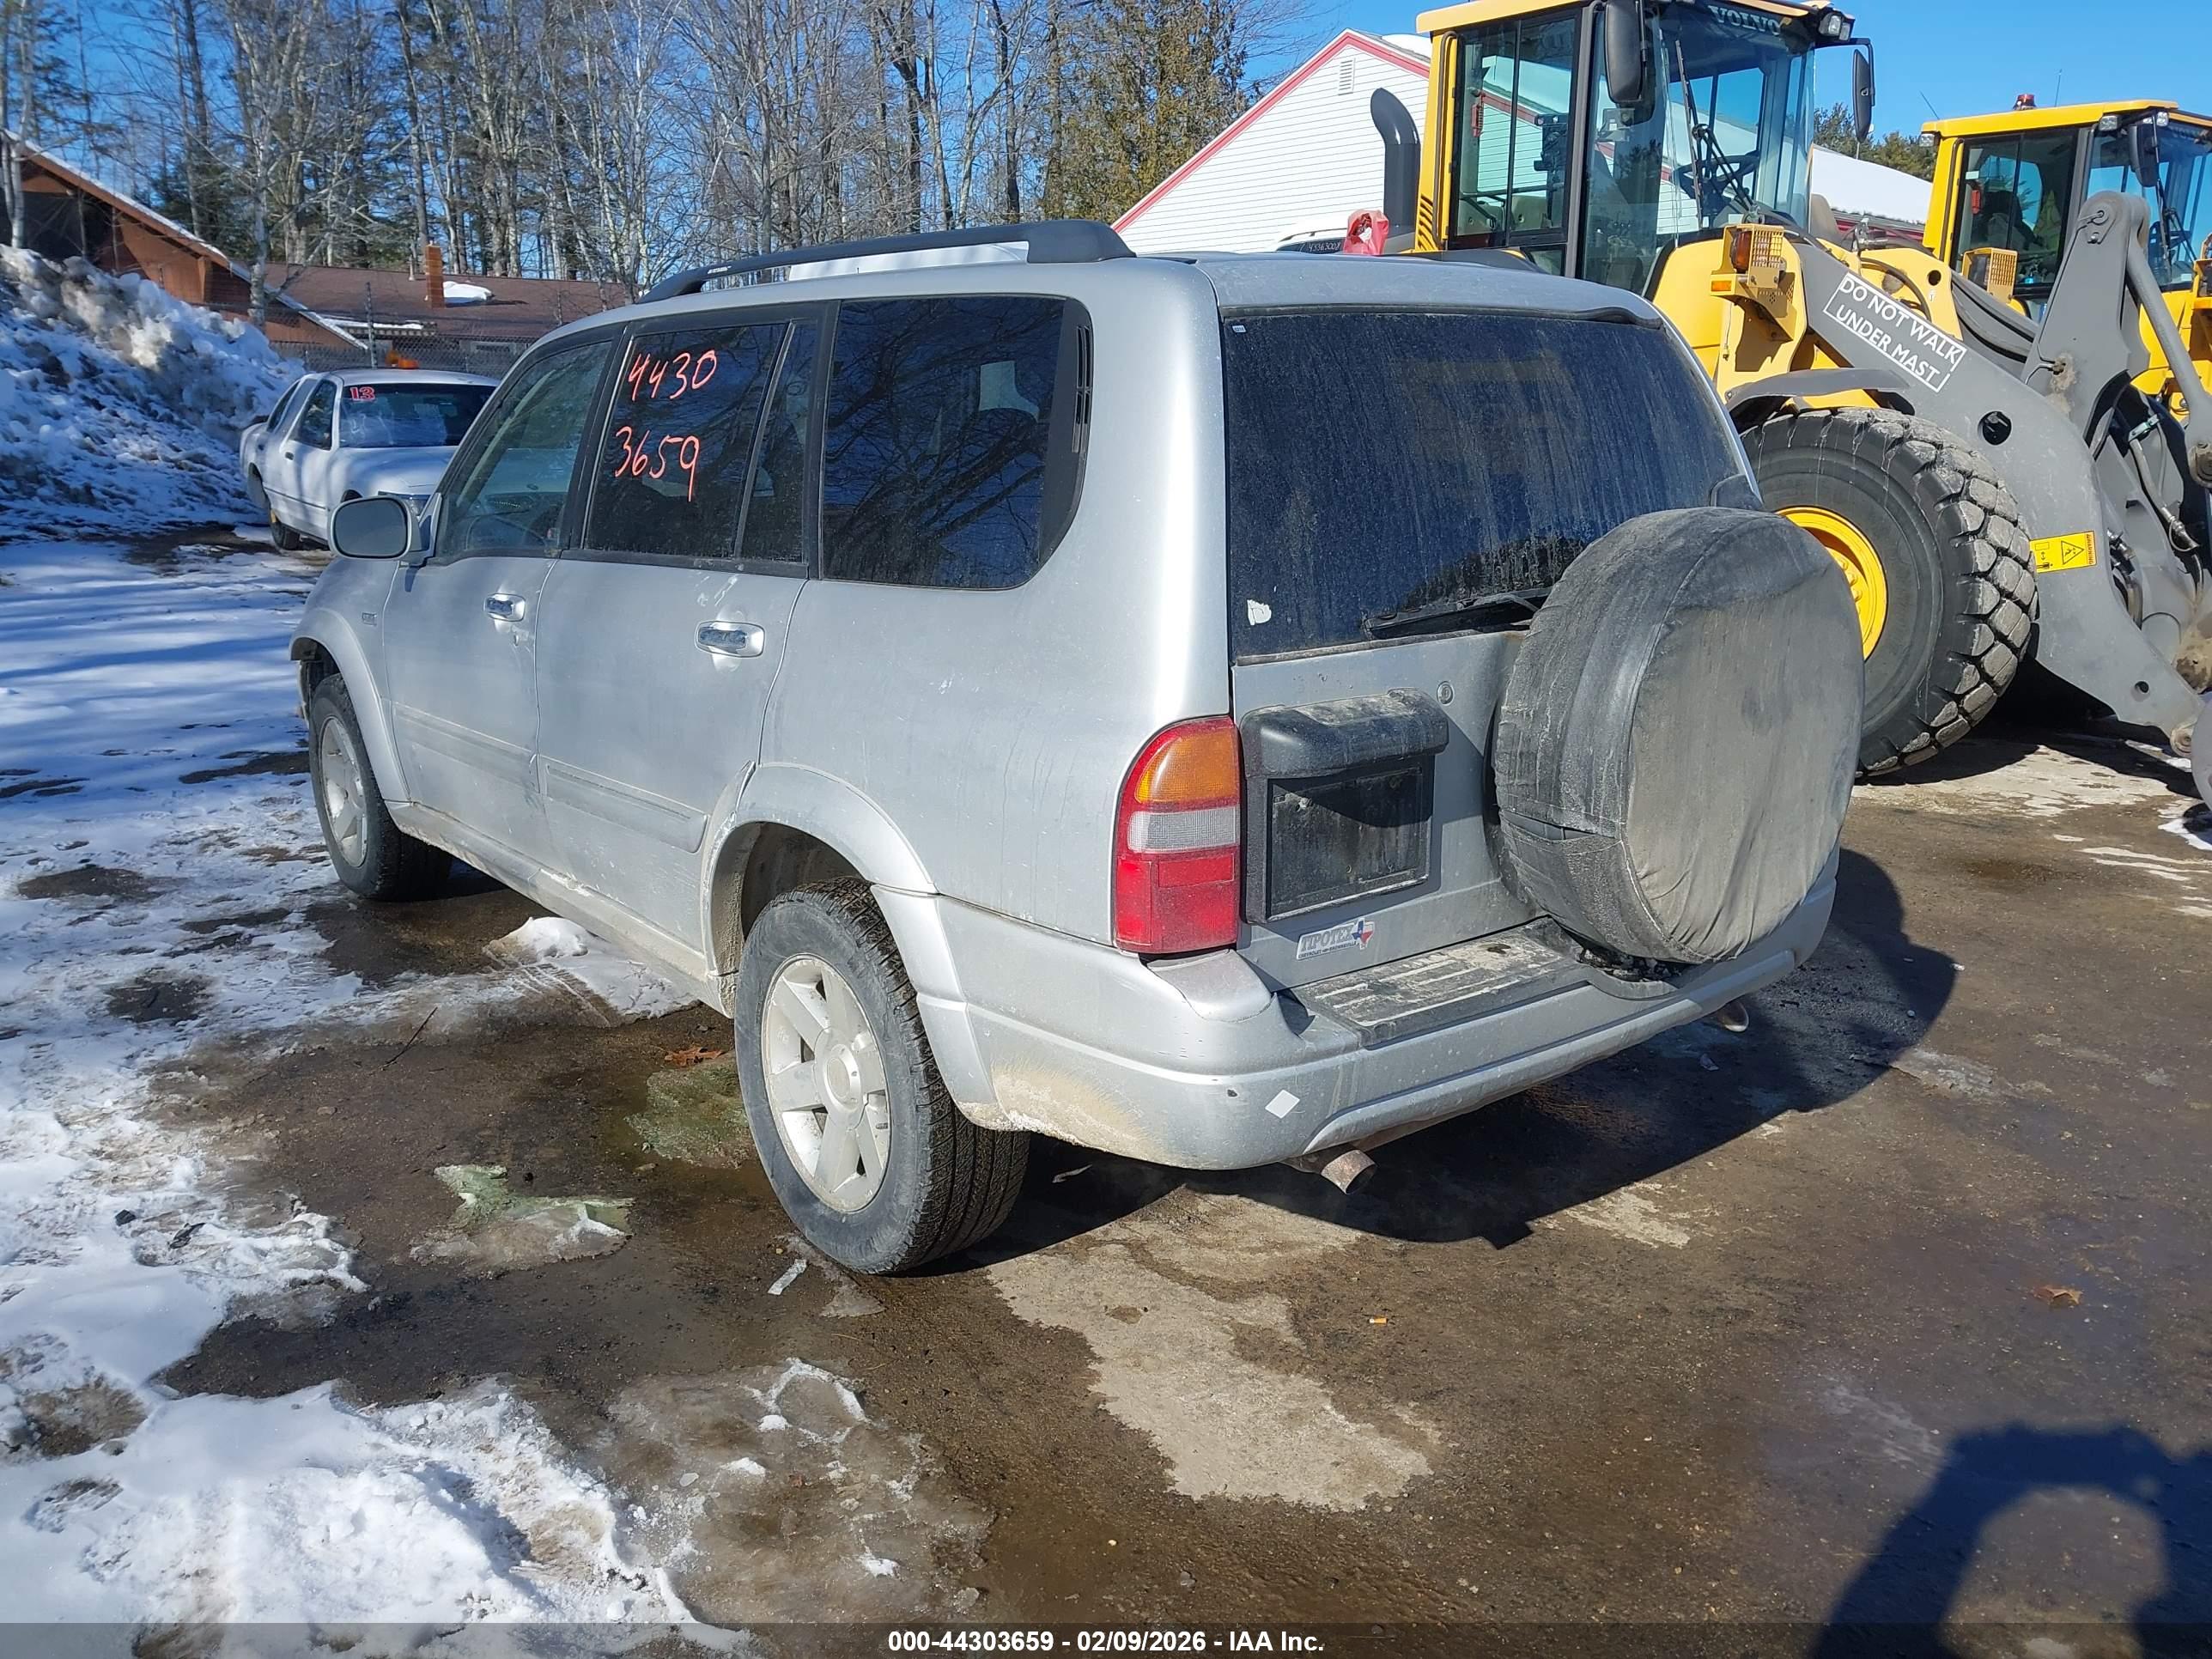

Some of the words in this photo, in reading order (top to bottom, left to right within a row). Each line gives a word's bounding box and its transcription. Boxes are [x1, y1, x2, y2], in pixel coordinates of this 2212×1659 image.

[1708, 5, 1780, 36] VOLVO
[1836, 304, 1892, 353] UNDER
[1891, 343, 1941, 383] MAST
[1839, 277, 1868, 302] DO
[1868, 295, 1909, 327] NOT
[1909, 320, 1963, 365] WALK
[349, 386, 376, 402] 13
[628, 349, 717, 402] 4430
[615, 426, 700, 502] 3659
[1301, 925, 1354, 952] TIPOTEX
